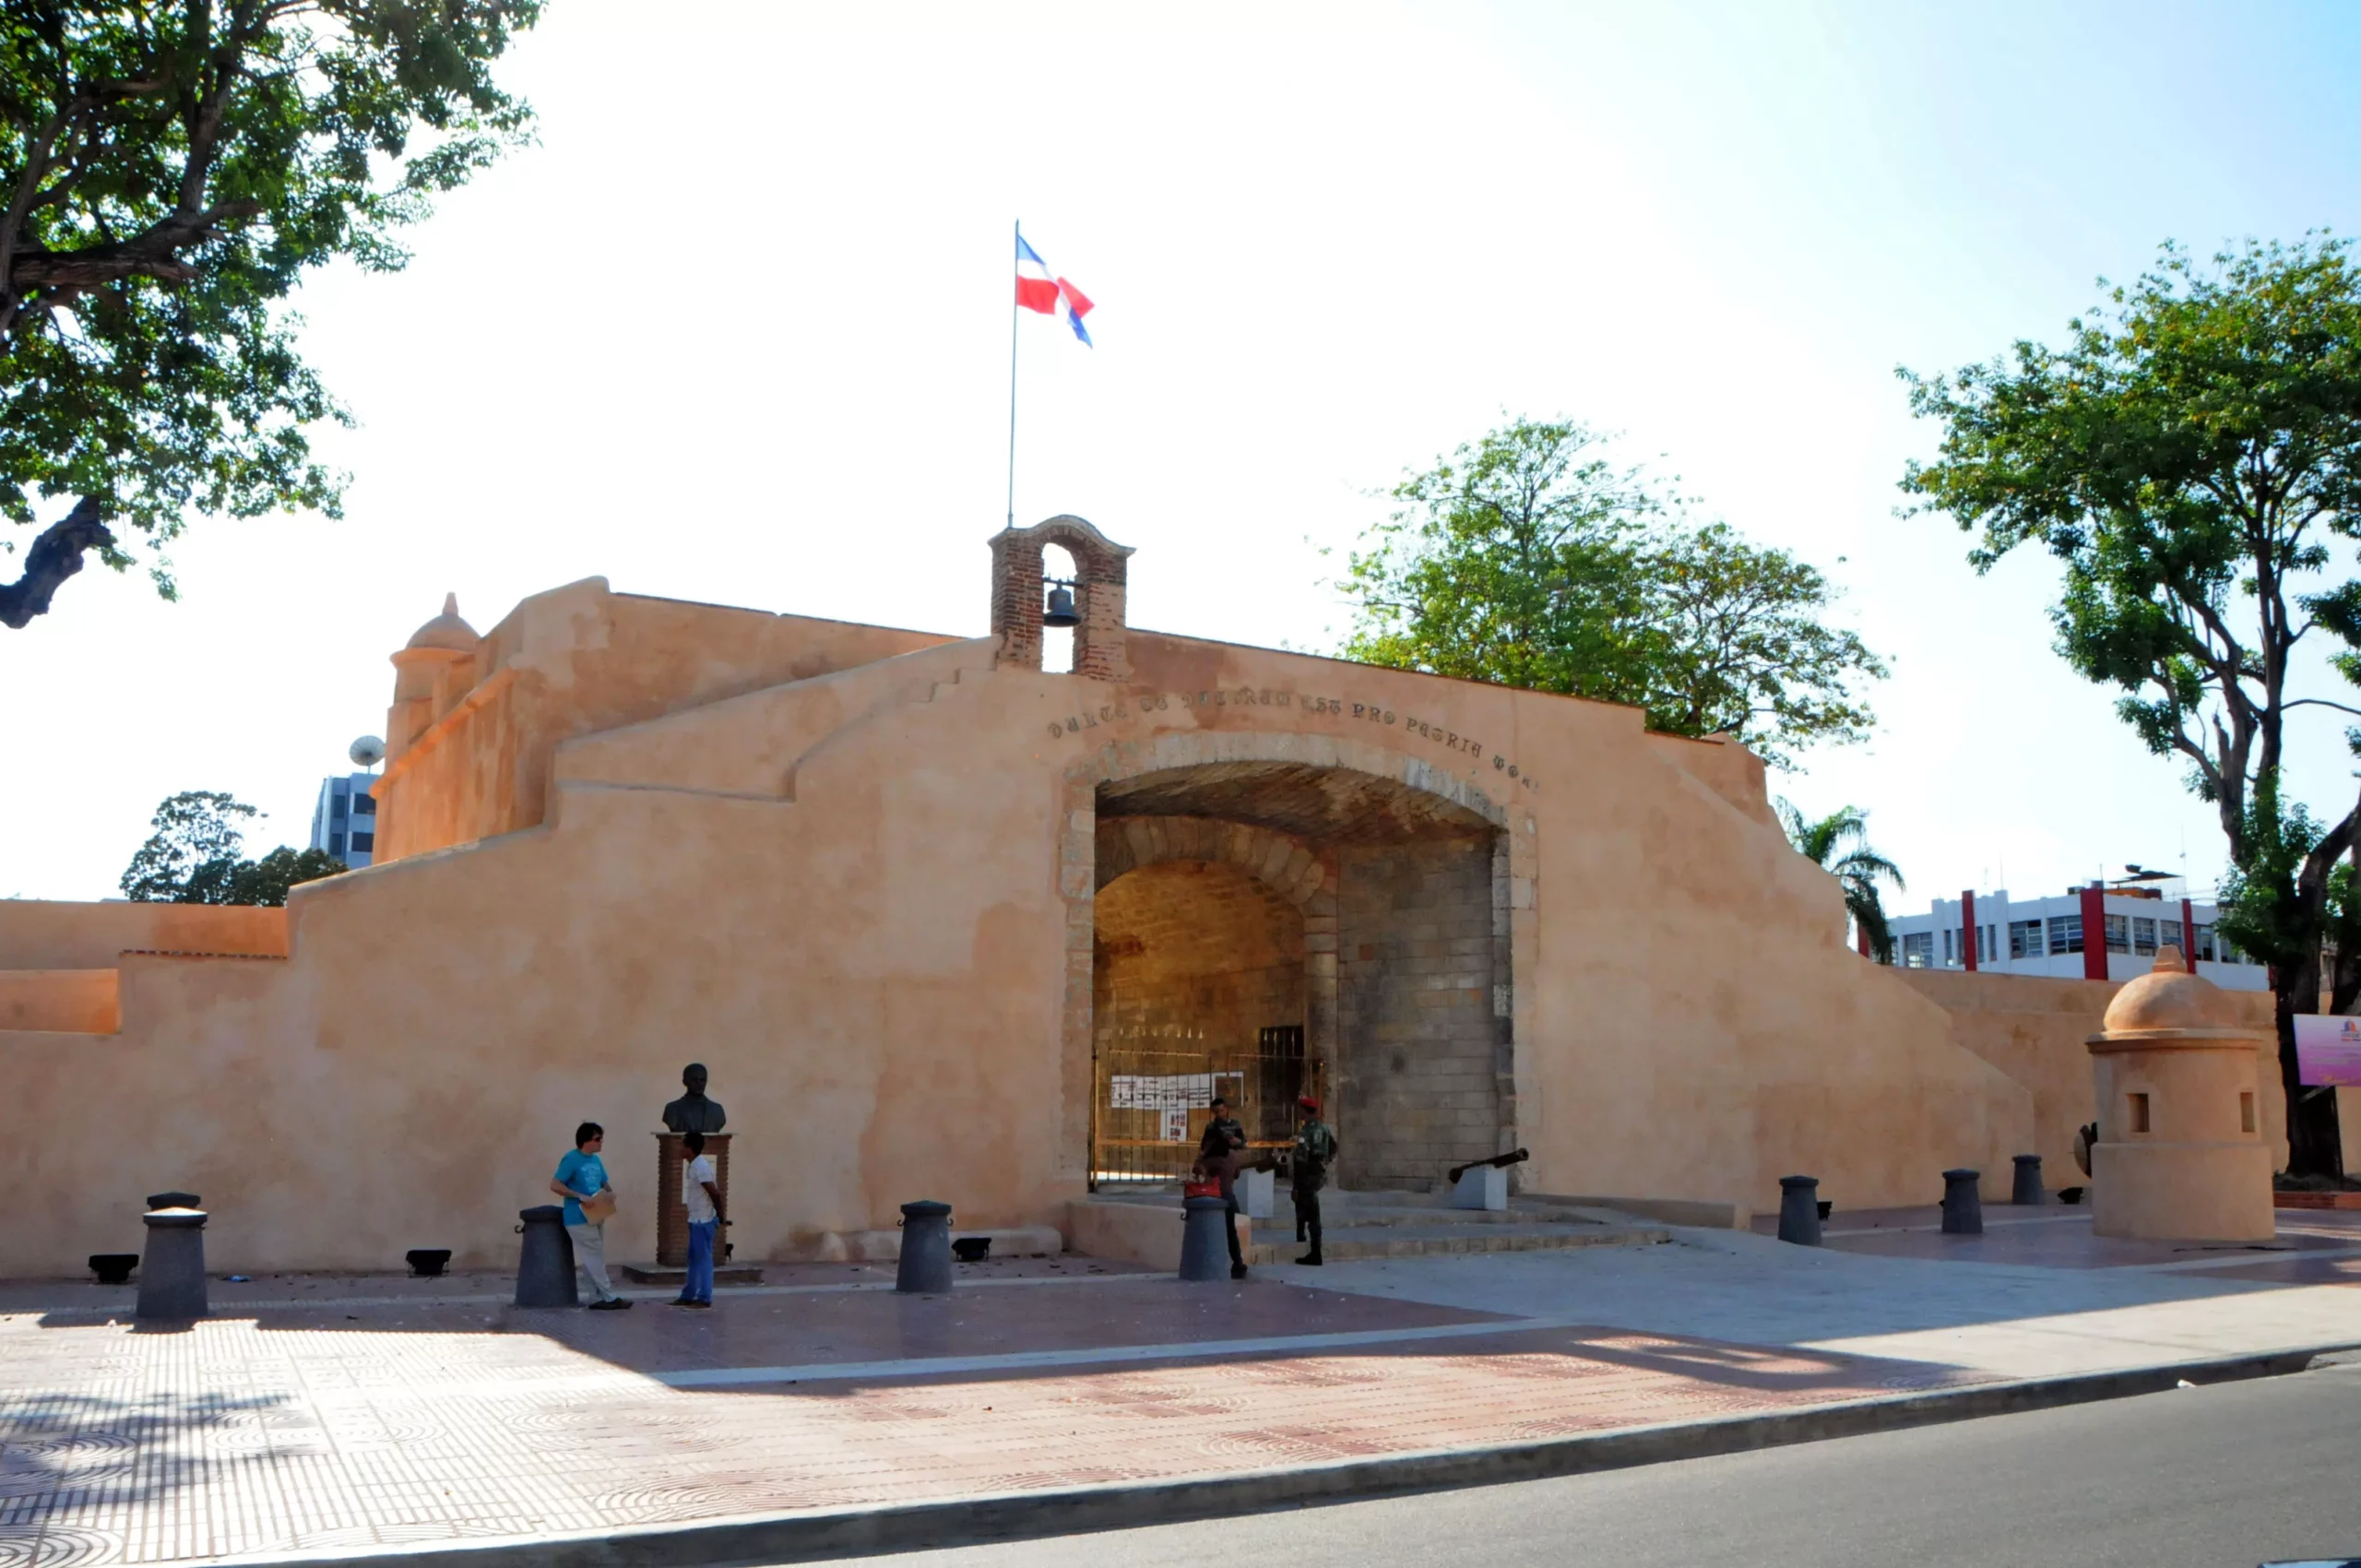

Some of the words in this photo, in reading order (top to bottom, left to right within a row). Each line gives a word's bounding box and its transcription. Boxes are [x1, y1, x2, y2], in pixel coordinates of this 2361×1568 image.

[1299, 695, 1341, 715] EST
[1351, 703, 1396, 725] PRO
[1406, 717, 1483, 758] PATRIA
